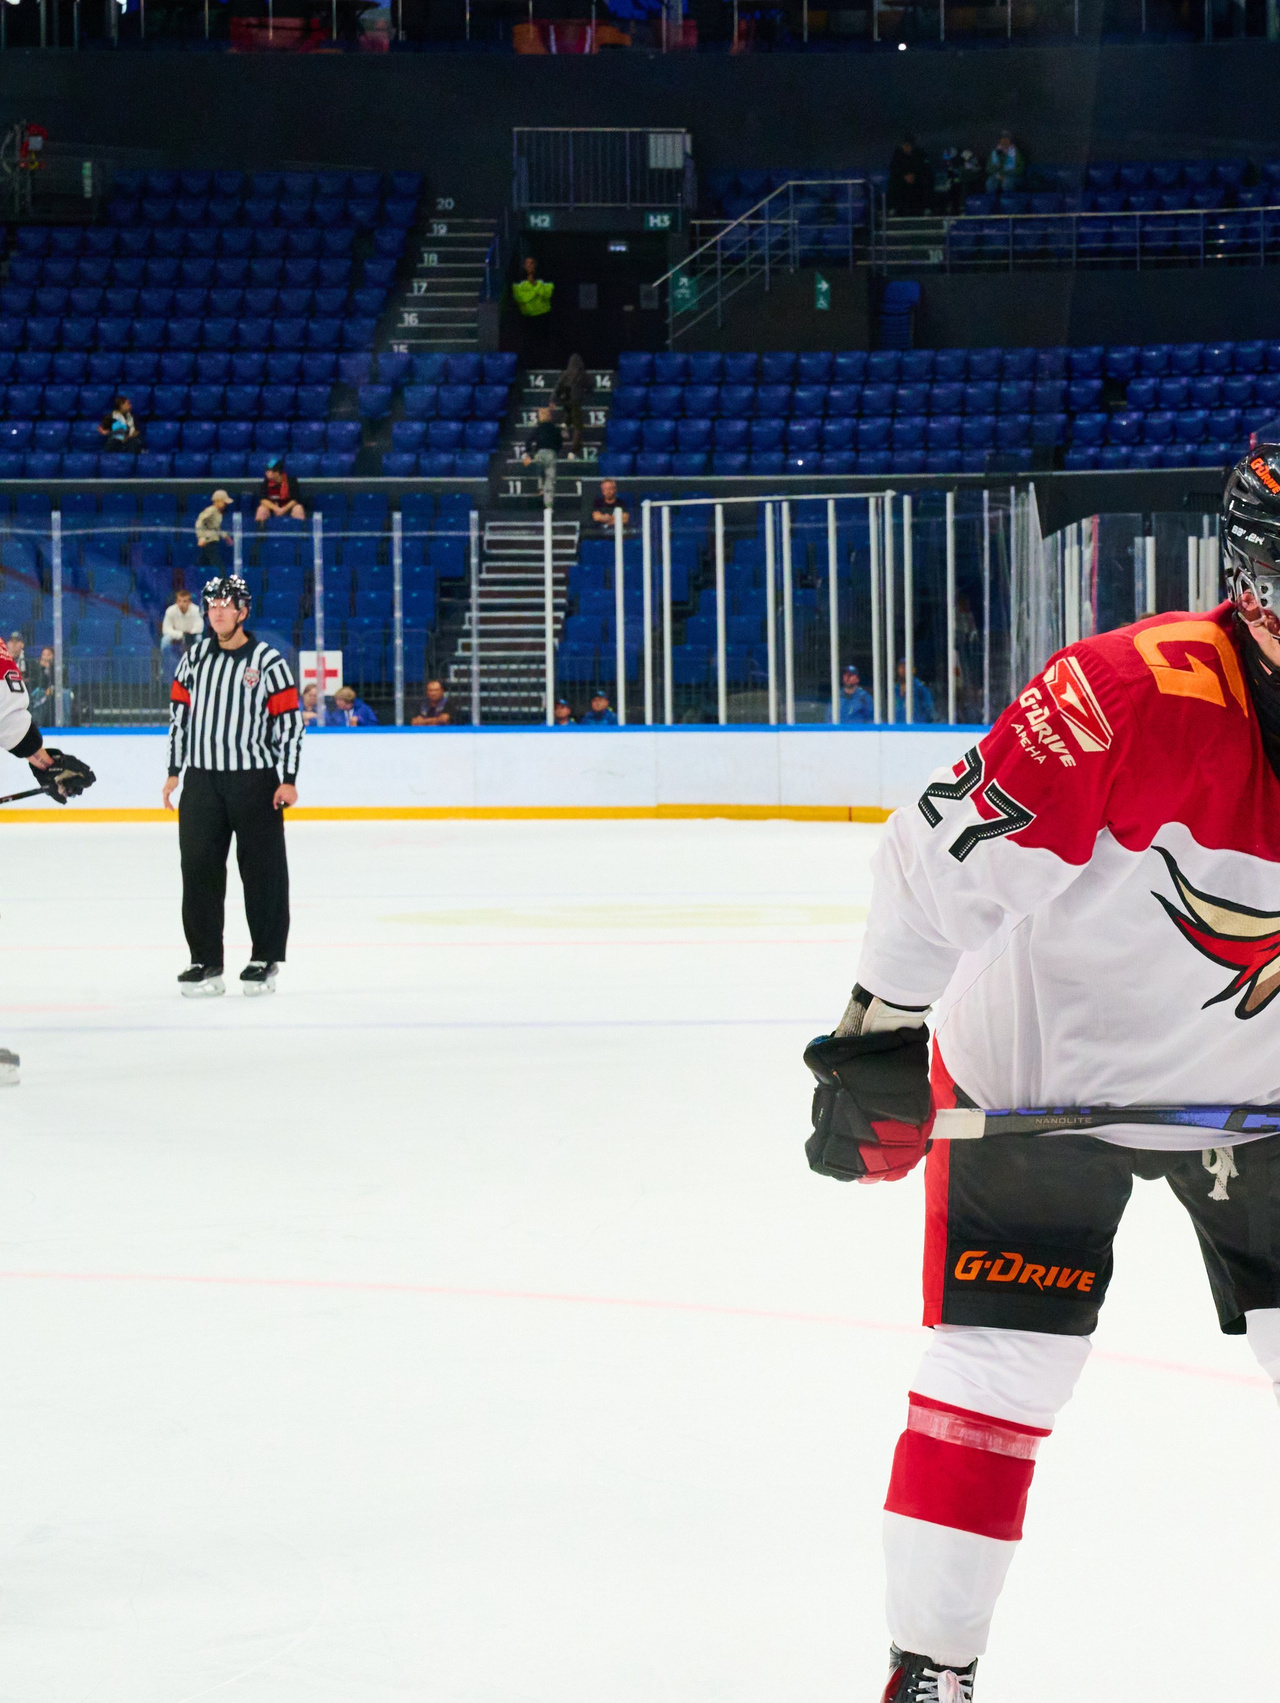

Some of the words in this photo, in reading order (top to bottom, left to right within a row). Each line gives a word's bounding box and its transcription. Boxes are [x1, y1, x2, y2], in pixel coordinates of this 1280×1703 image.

[436, 198, 455, 211] 20
[530, 214, 551, 228] H2
[649, 214, 671, 228] H3
[412, 282, 428, 295] 17
[402, 312, 419, 326] 16
[529, 375, 545, 388] 14
[595, 375, 611, 389] 14
[522, 412, 538, 426] 13
[589, 411, 606, 426] 13
[582, 446, 598, 460] 12
[509, 480, 522, 495] 11
[1010, 723, 1047, 764] АРЕНА
[918, 744, 1037, 863] 27
[1035, 1116, 1093, 1125] NANOLITE
